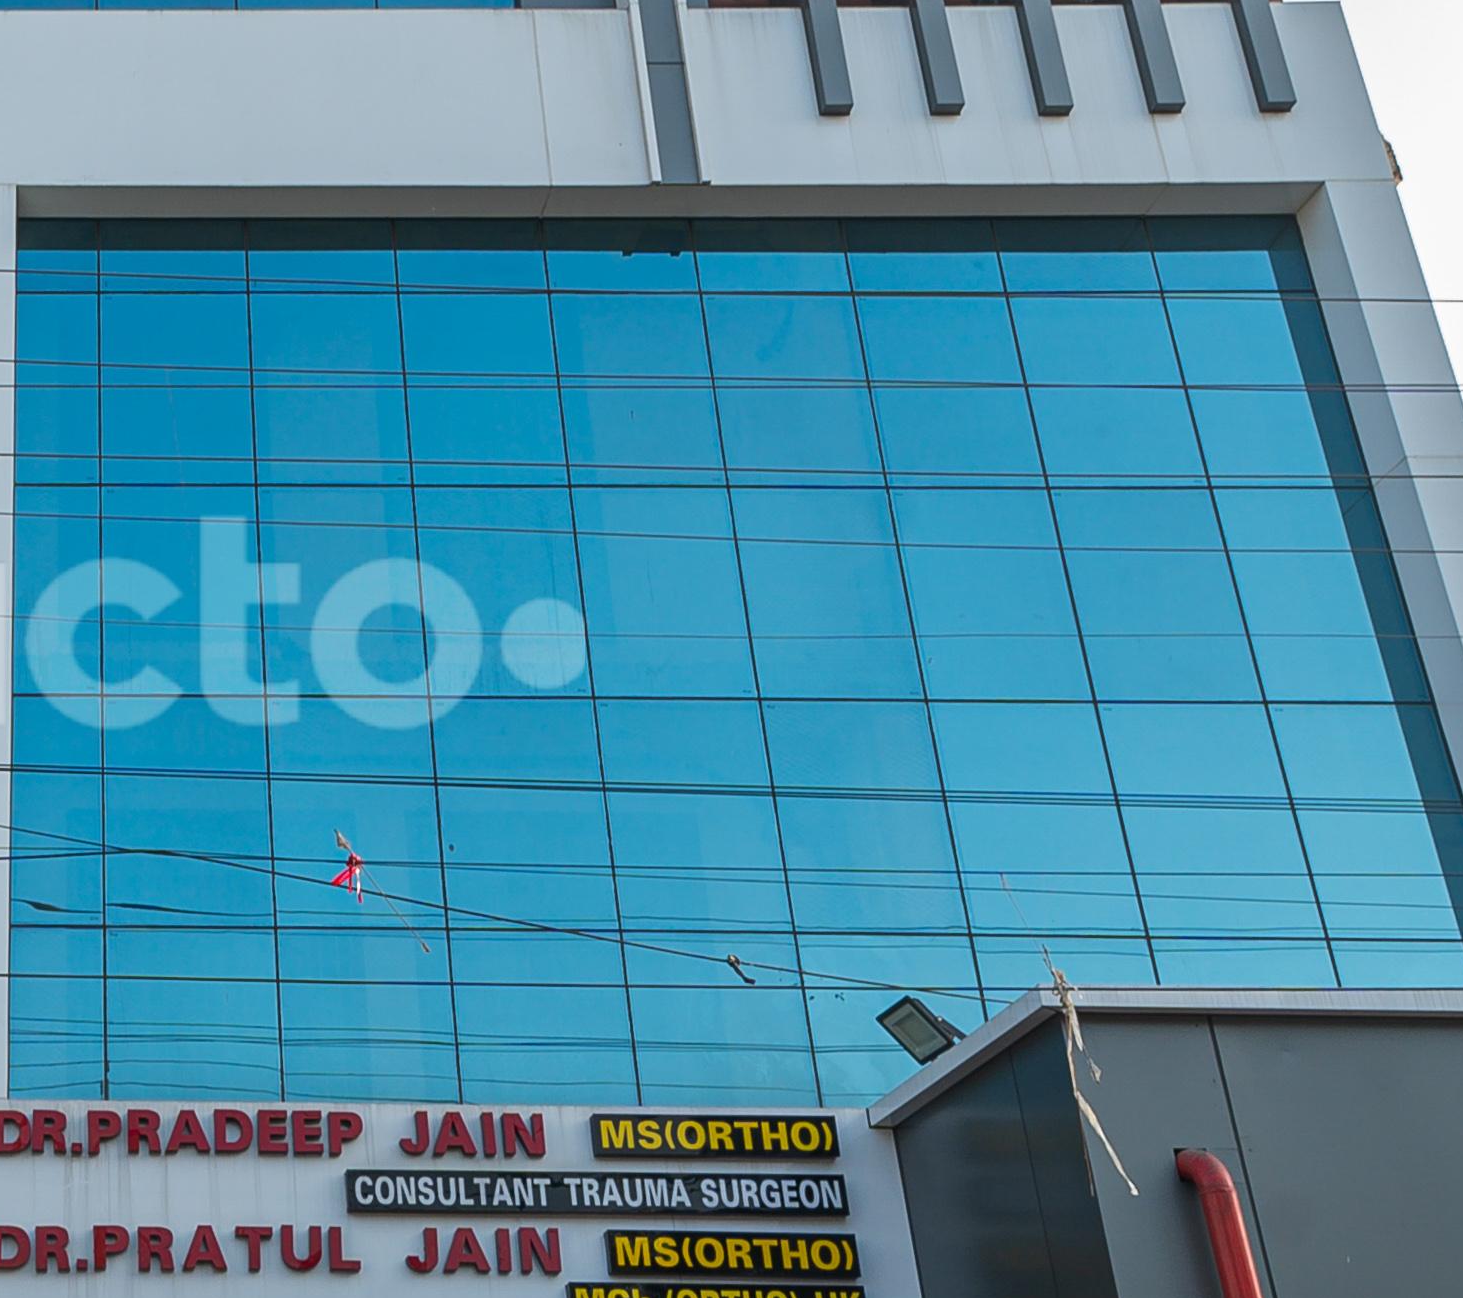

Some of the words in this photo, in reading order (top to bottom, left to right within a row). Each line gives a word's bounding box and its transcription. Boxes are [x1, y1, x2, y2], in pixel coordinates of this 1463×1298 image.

[399, 1111, 546, 1158] JAIN
[600, 1119, 833, 1152] MS(ORTHO)
[354, 1176, 551, 1208] CONSULTANT
[566, 1177, 692, 1208] TRAUMA
[701, 1178, 843, 1210] SURGEON
[405, 1227, 561, 1274] JAIN
[615, 1236, 854, 1272] MS(ORTHO)
